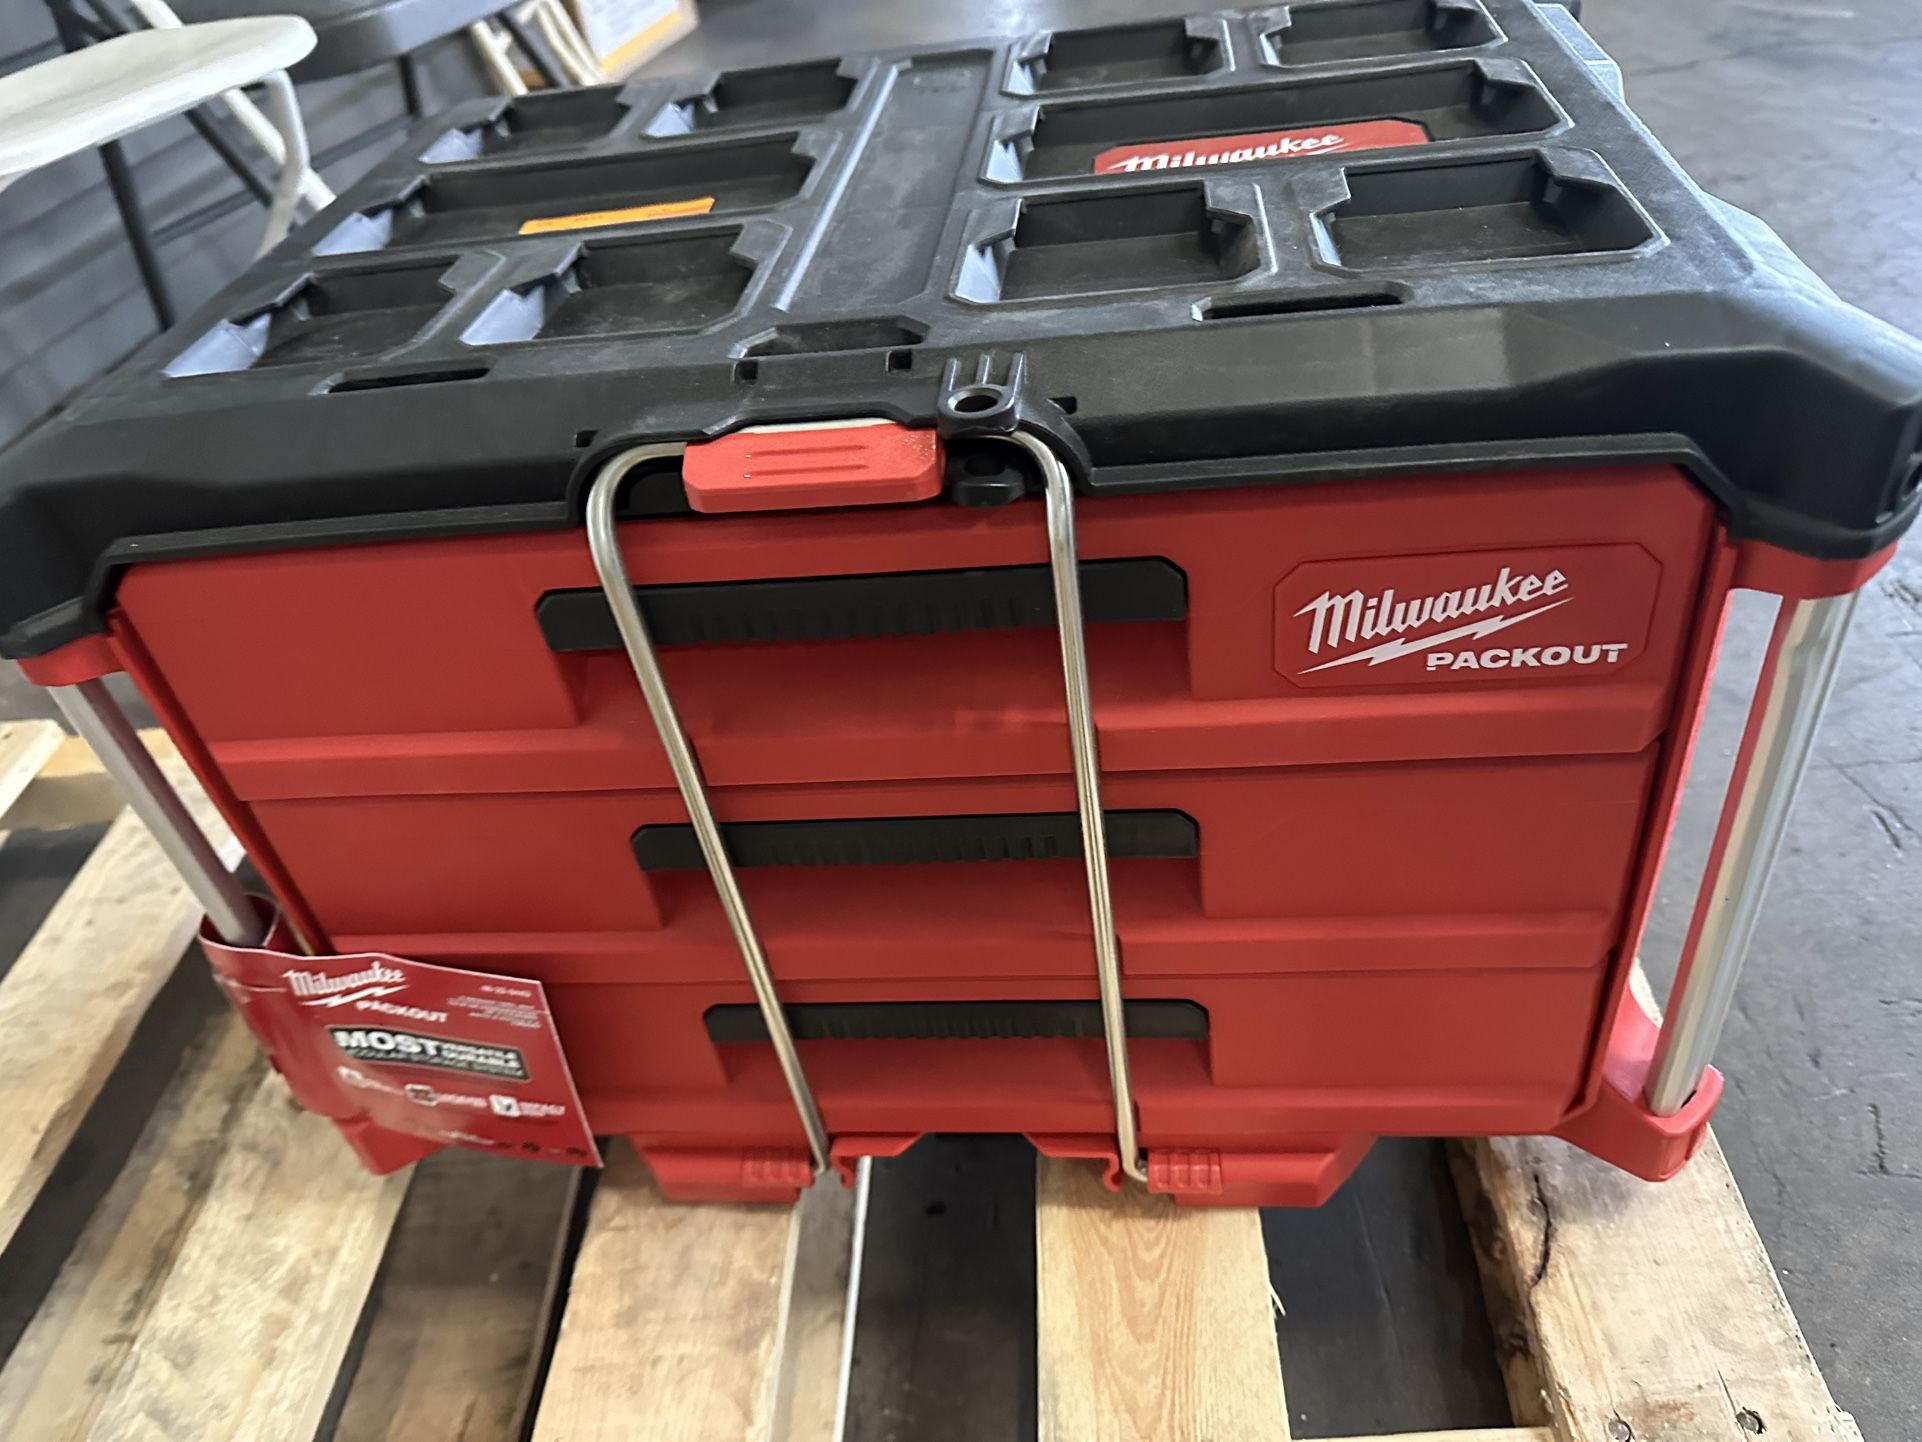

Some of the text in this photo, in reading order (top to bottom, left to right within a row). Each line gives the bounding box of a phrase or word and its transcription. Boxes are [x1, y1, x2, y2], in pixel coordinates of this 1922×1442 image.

[1107, 133, 1344, 172] Milwaukee
[1293, 567, 1569, 654] Milwaukee
[1426, 643, 1628, 671] PACKOUT
[282, 961, 406, 996] Milwaukee
[333, 1030, 440, 1056] MOST
